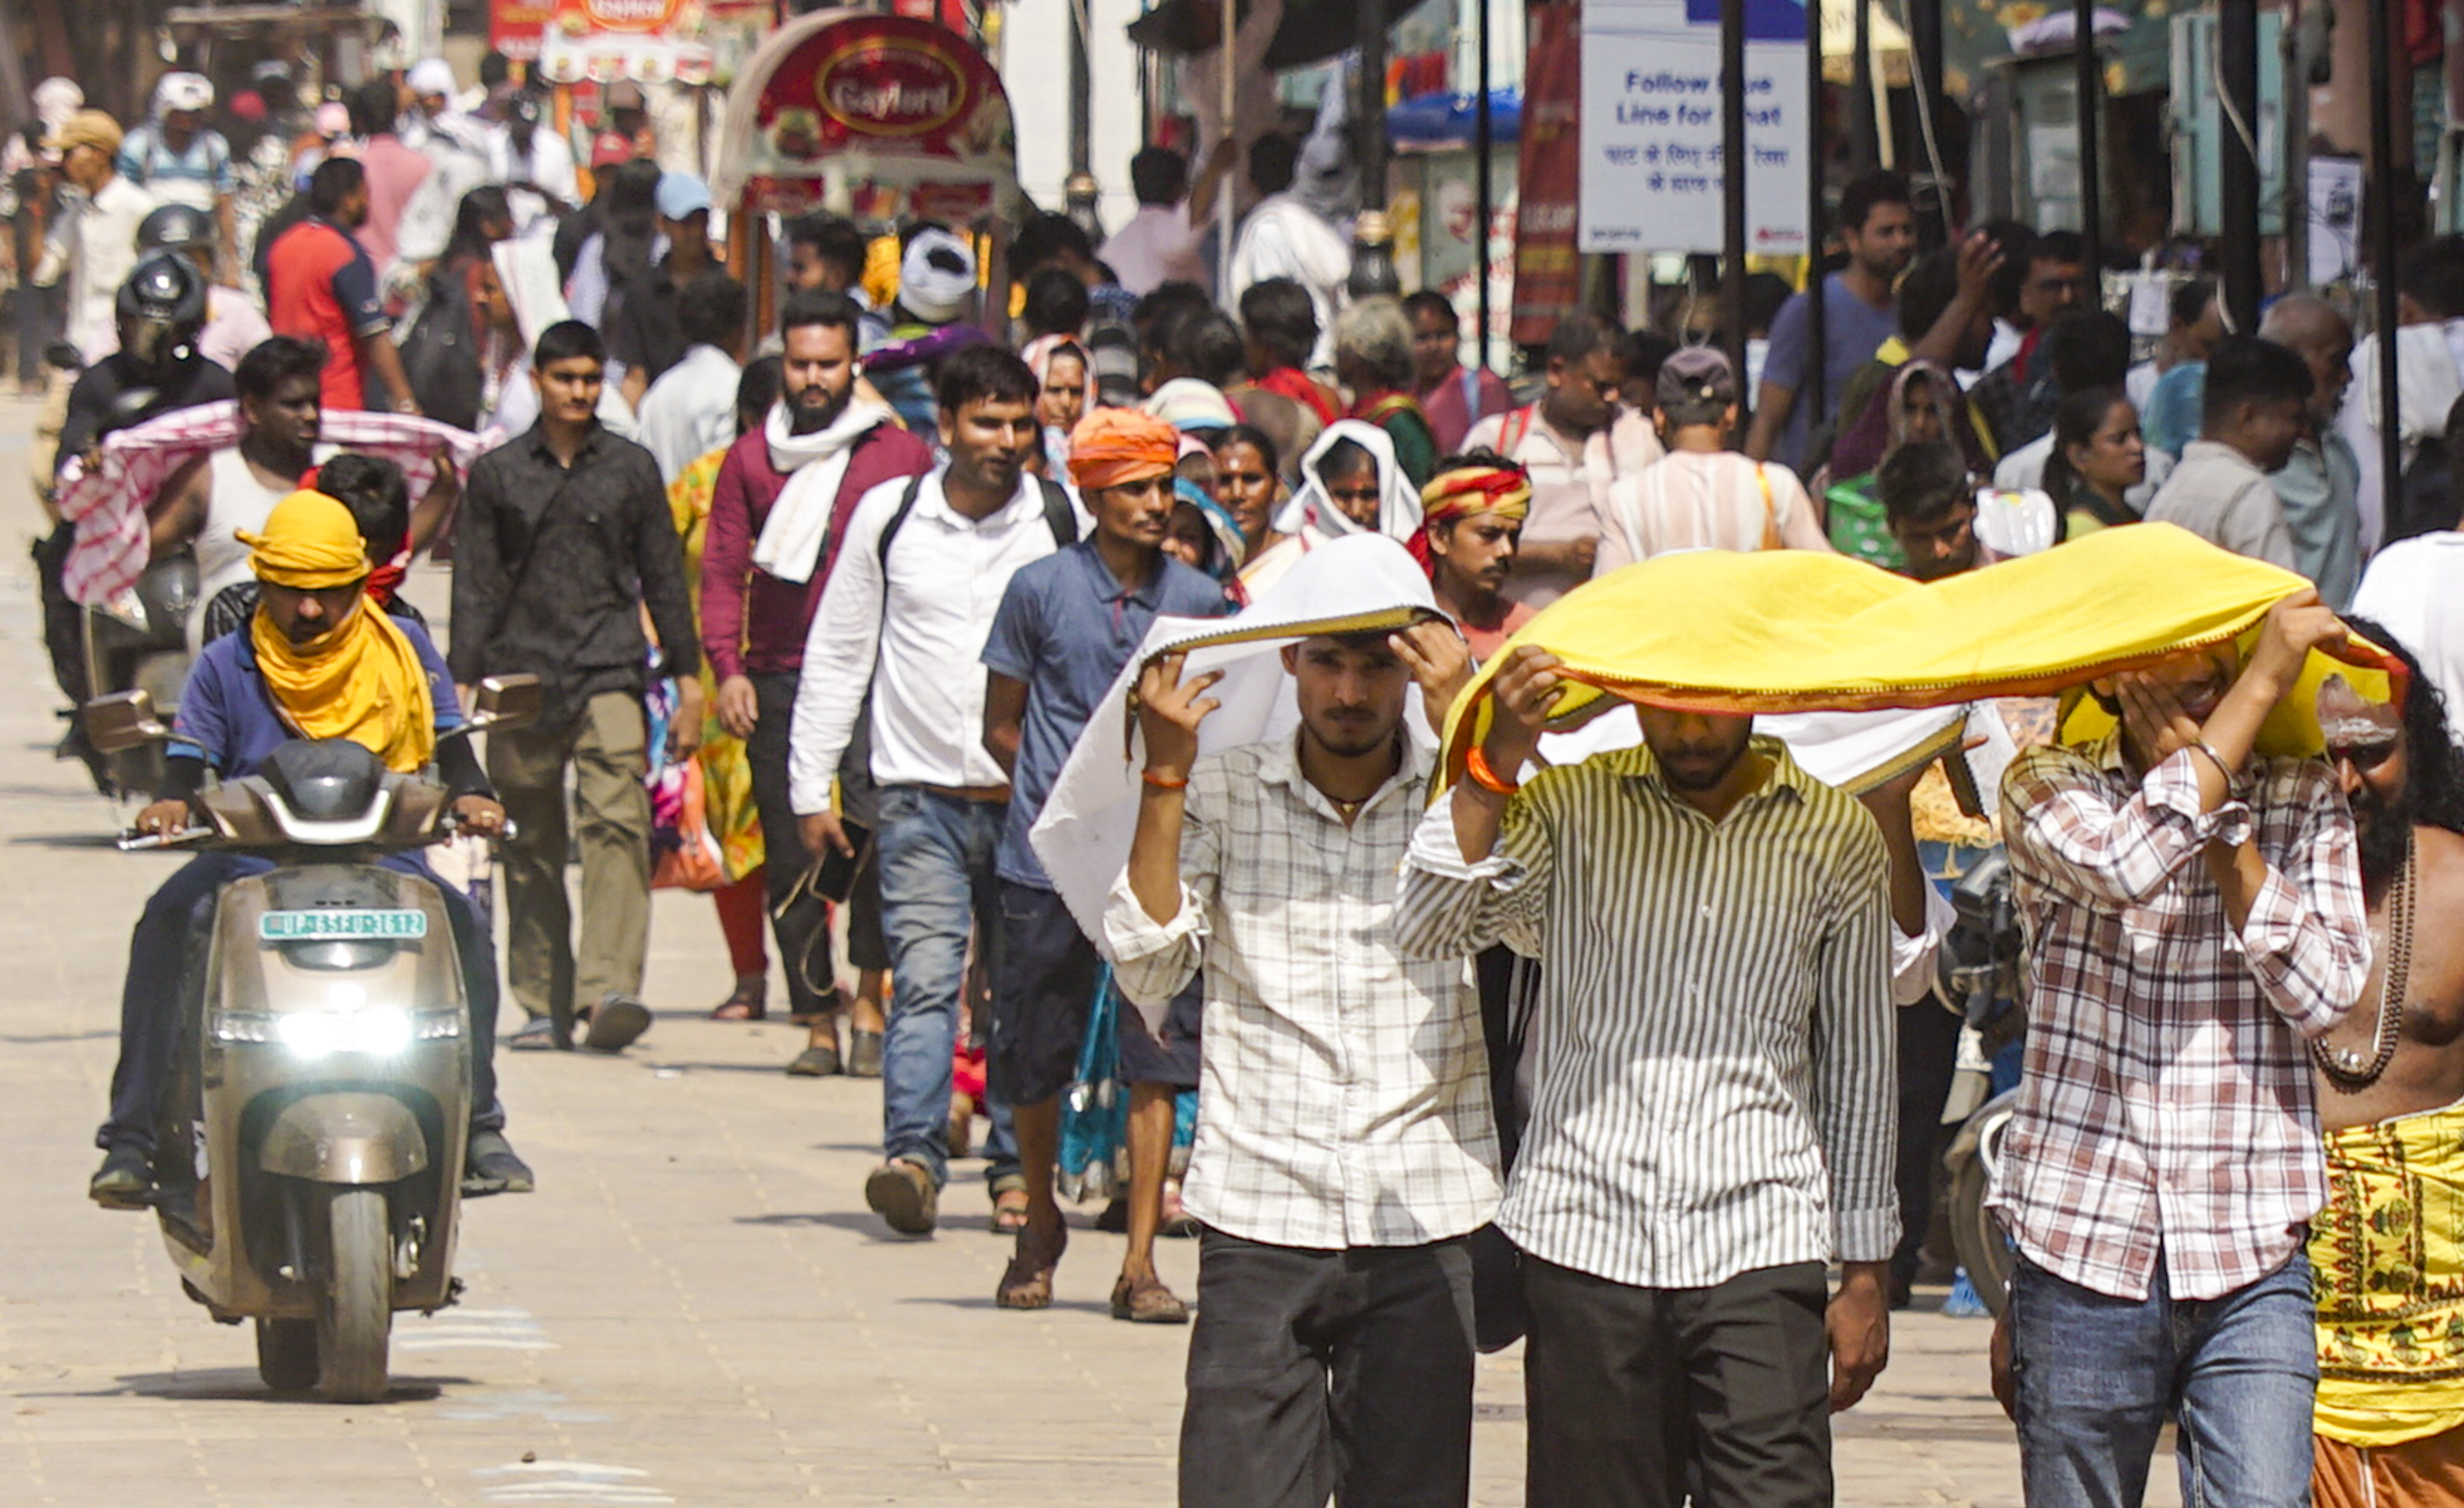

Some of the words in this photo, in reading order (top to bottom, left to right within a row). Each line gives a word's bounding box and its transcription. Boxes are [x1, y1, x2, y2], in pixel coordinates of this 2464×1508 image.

[1625, 70, 1709, 93] Follow
[832, 79, 951, 120] Gaylord
[1616, 102, 1670, 125] Line
[1678, 102, 1712, 125] for
